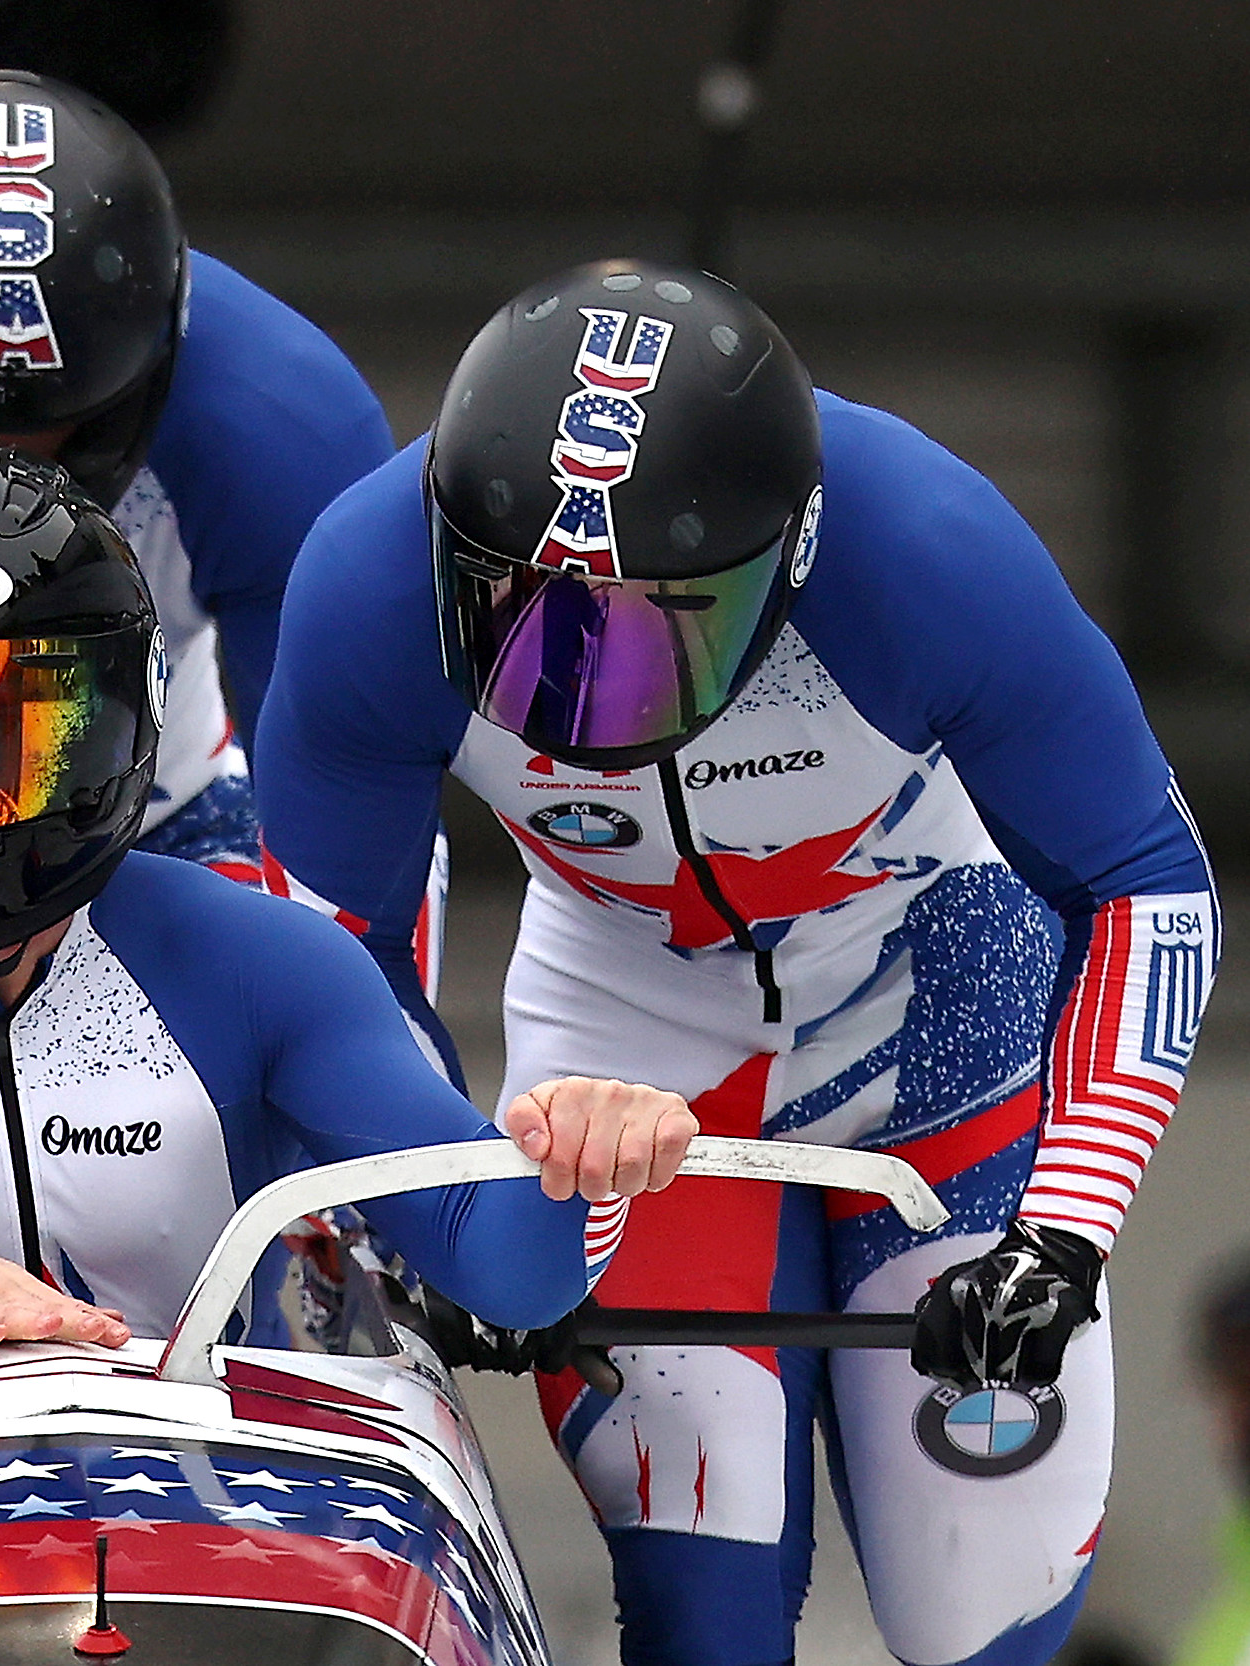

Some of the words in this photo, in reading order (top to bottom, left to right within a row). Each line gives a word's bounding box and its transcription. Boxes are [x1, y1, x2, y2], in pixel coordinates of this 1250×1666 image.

[532, 308, 673, 581] USA
[684, 749, 826, 790] Omaze
[519, 781, 571, 790] UNDER
[573, 783, 642, 792] ARMOUR
[538, 804, 628, 824] BMW
[1152, 912, 1202, 935] USA
[41, 1114, 162, 1156] Omaze
